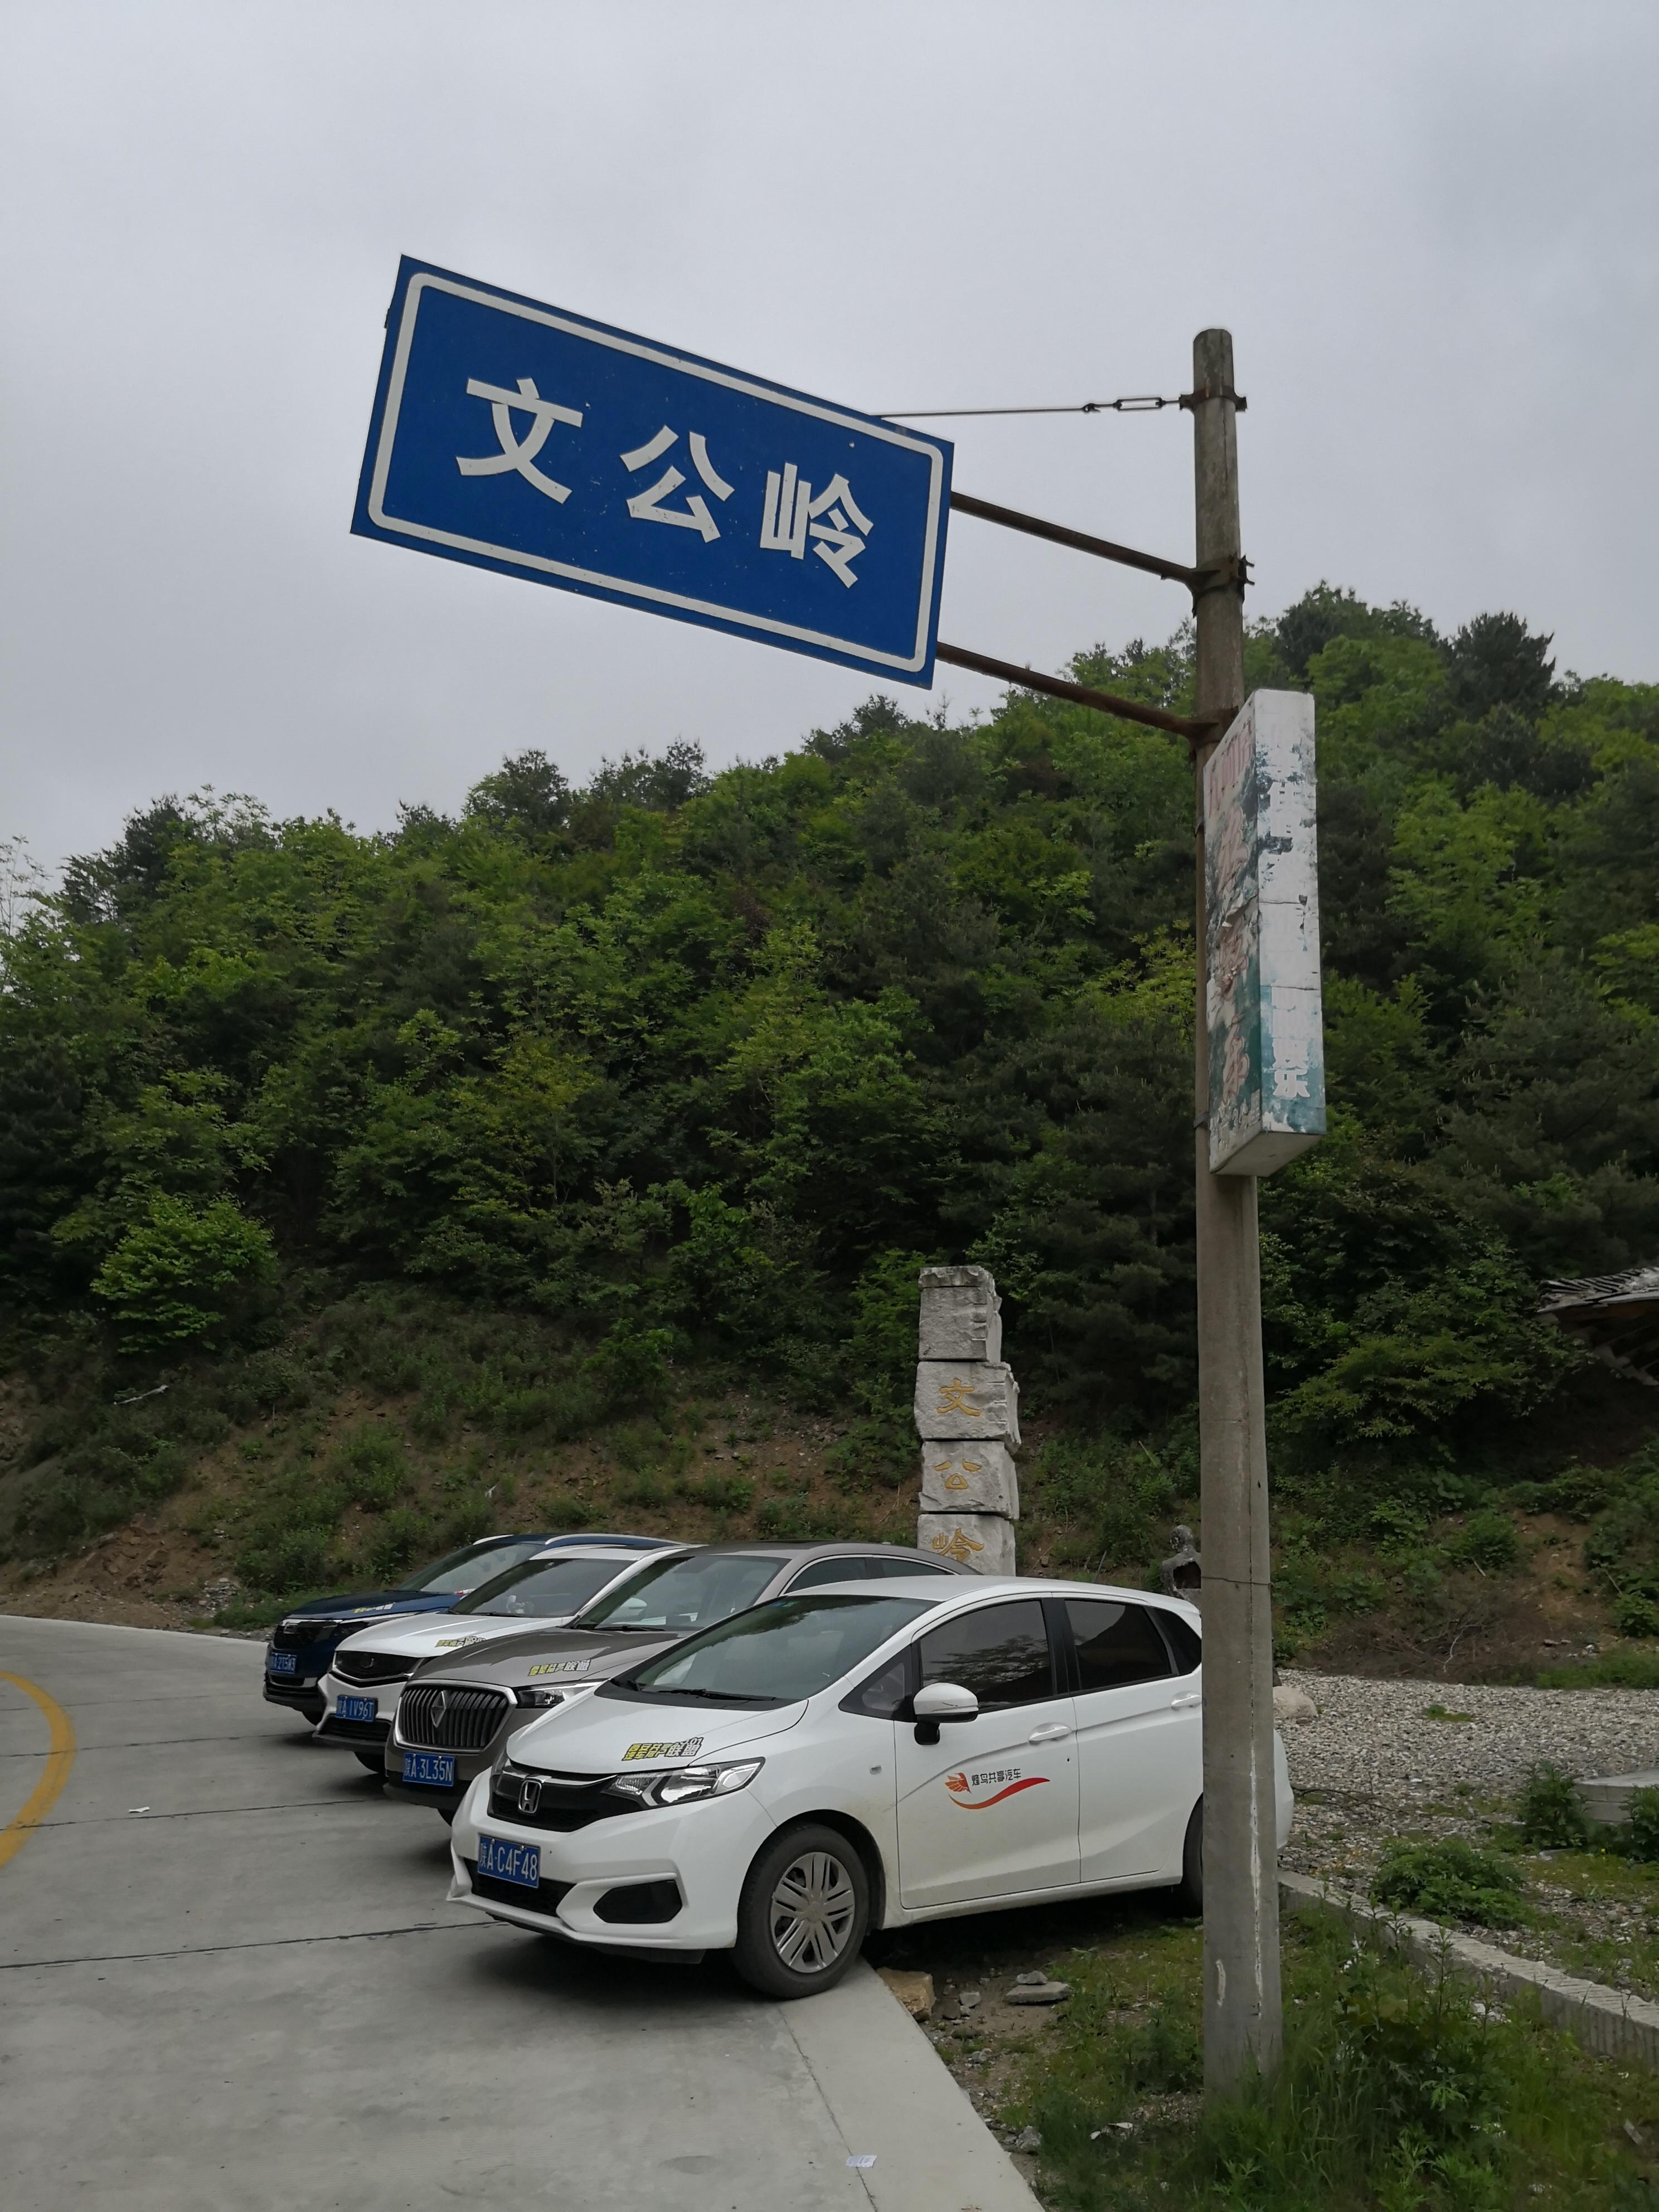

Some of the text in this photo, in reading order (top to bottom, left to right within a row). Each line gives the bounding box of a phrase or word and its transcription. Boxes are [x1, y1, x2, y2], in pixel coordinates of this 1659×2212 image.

[455, 377, 874, 589] 文公岭
[932, 1379, 984, 1560] 文公岭
[972, 1768, 1021, 1786] 蜂鸟共享汽车
